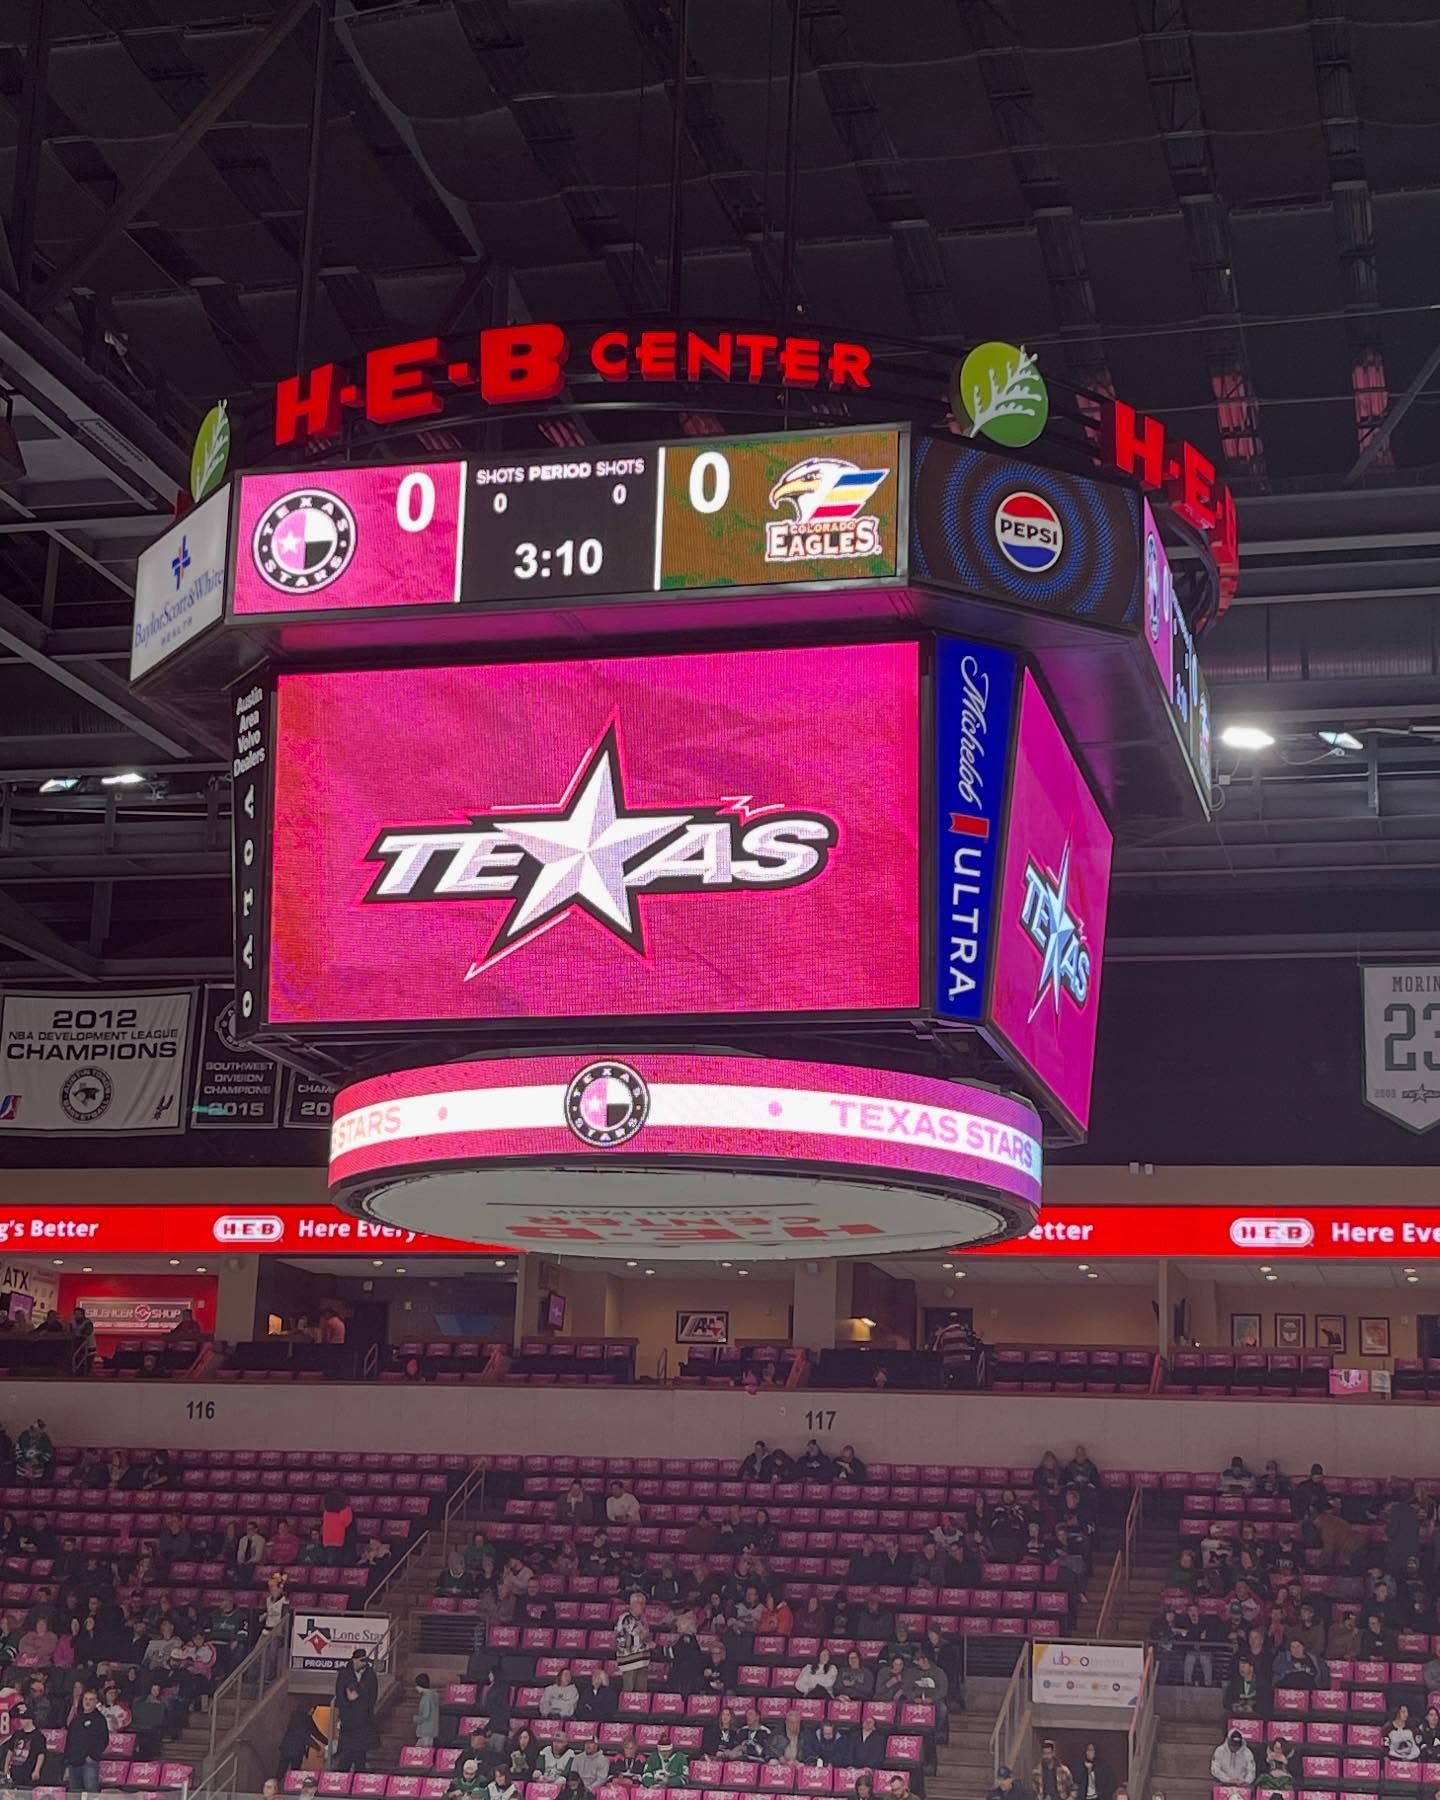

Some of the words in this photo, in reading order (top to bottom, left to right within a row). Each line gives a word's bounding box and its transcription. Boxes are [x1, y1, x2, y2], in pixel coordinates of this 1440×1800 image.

[591, 331, 872, 390] CENTER
[476, 467, 524, 485] SHOTS
[528, 462, 592, 481] PERIOD
[596, 458, 645, 477] SHOTS
[689, 451, 730, 513] 0
[396, 471, 436, 533] 0
[493, 493, 508, 514] 0
[612, 484, 627, 504] 0
[262, 496, 348, 536] TEXAS
[769, 518, 876, 557] EAGLES
[790, 521, 857, 534] COLORADO
[1000, 519, 1058, 546] PEPSI
[514, 538, 603, 579] 3:10
[264, 555, 343, 587] STARS
[239, 710, 260, 733] Area
[237, 730, 261, 754] Volvo
[958, 655, 989, 811] Michelob
[233, 747, 266, 777] Dealers
[948, 848, 982, 1000] ULTRA
[53, 1009, 137, 1029] 2012
[9, 1031, 34, 1040] NBA
[38, 1031, 127, 1041] DEVELOPMENT
[131, 1029, 178, 1040] LEAGUE
[7, 1042, 177, 1060] CHAMPIONS
[206, 1062, 274, 1071] SOUTHWEST
[214, 1074, 264, 1082] DIVISION
[204, 1086, 271, 1094] CHAMPIONS
[208, 1102, 264, 1116] 2015
[339, 1106, 401, 1149] STARS
[831, 1099, 959, 1143] TEXAS
[966, 1121, 1032, 1168] STARS
[31, 1219, 99, 1237] Better
[299, 1219, 351, 1237] Here
[1018, 1221, 1094, 1240] etter
[1332, 1222, 1394, 1242] Here
[3, 1267, 29, 1290] ATX
[151, 1308, 181, 1318] SHOP
[186, 1401, 215, 1420] 116
[805, 1411, 836, 1430] 117
[332, 1628, 360, 1641] Lone
[304, 1659, 333, 1668] PROUD
[1053, 1650, 1090, 1667] ubeo
